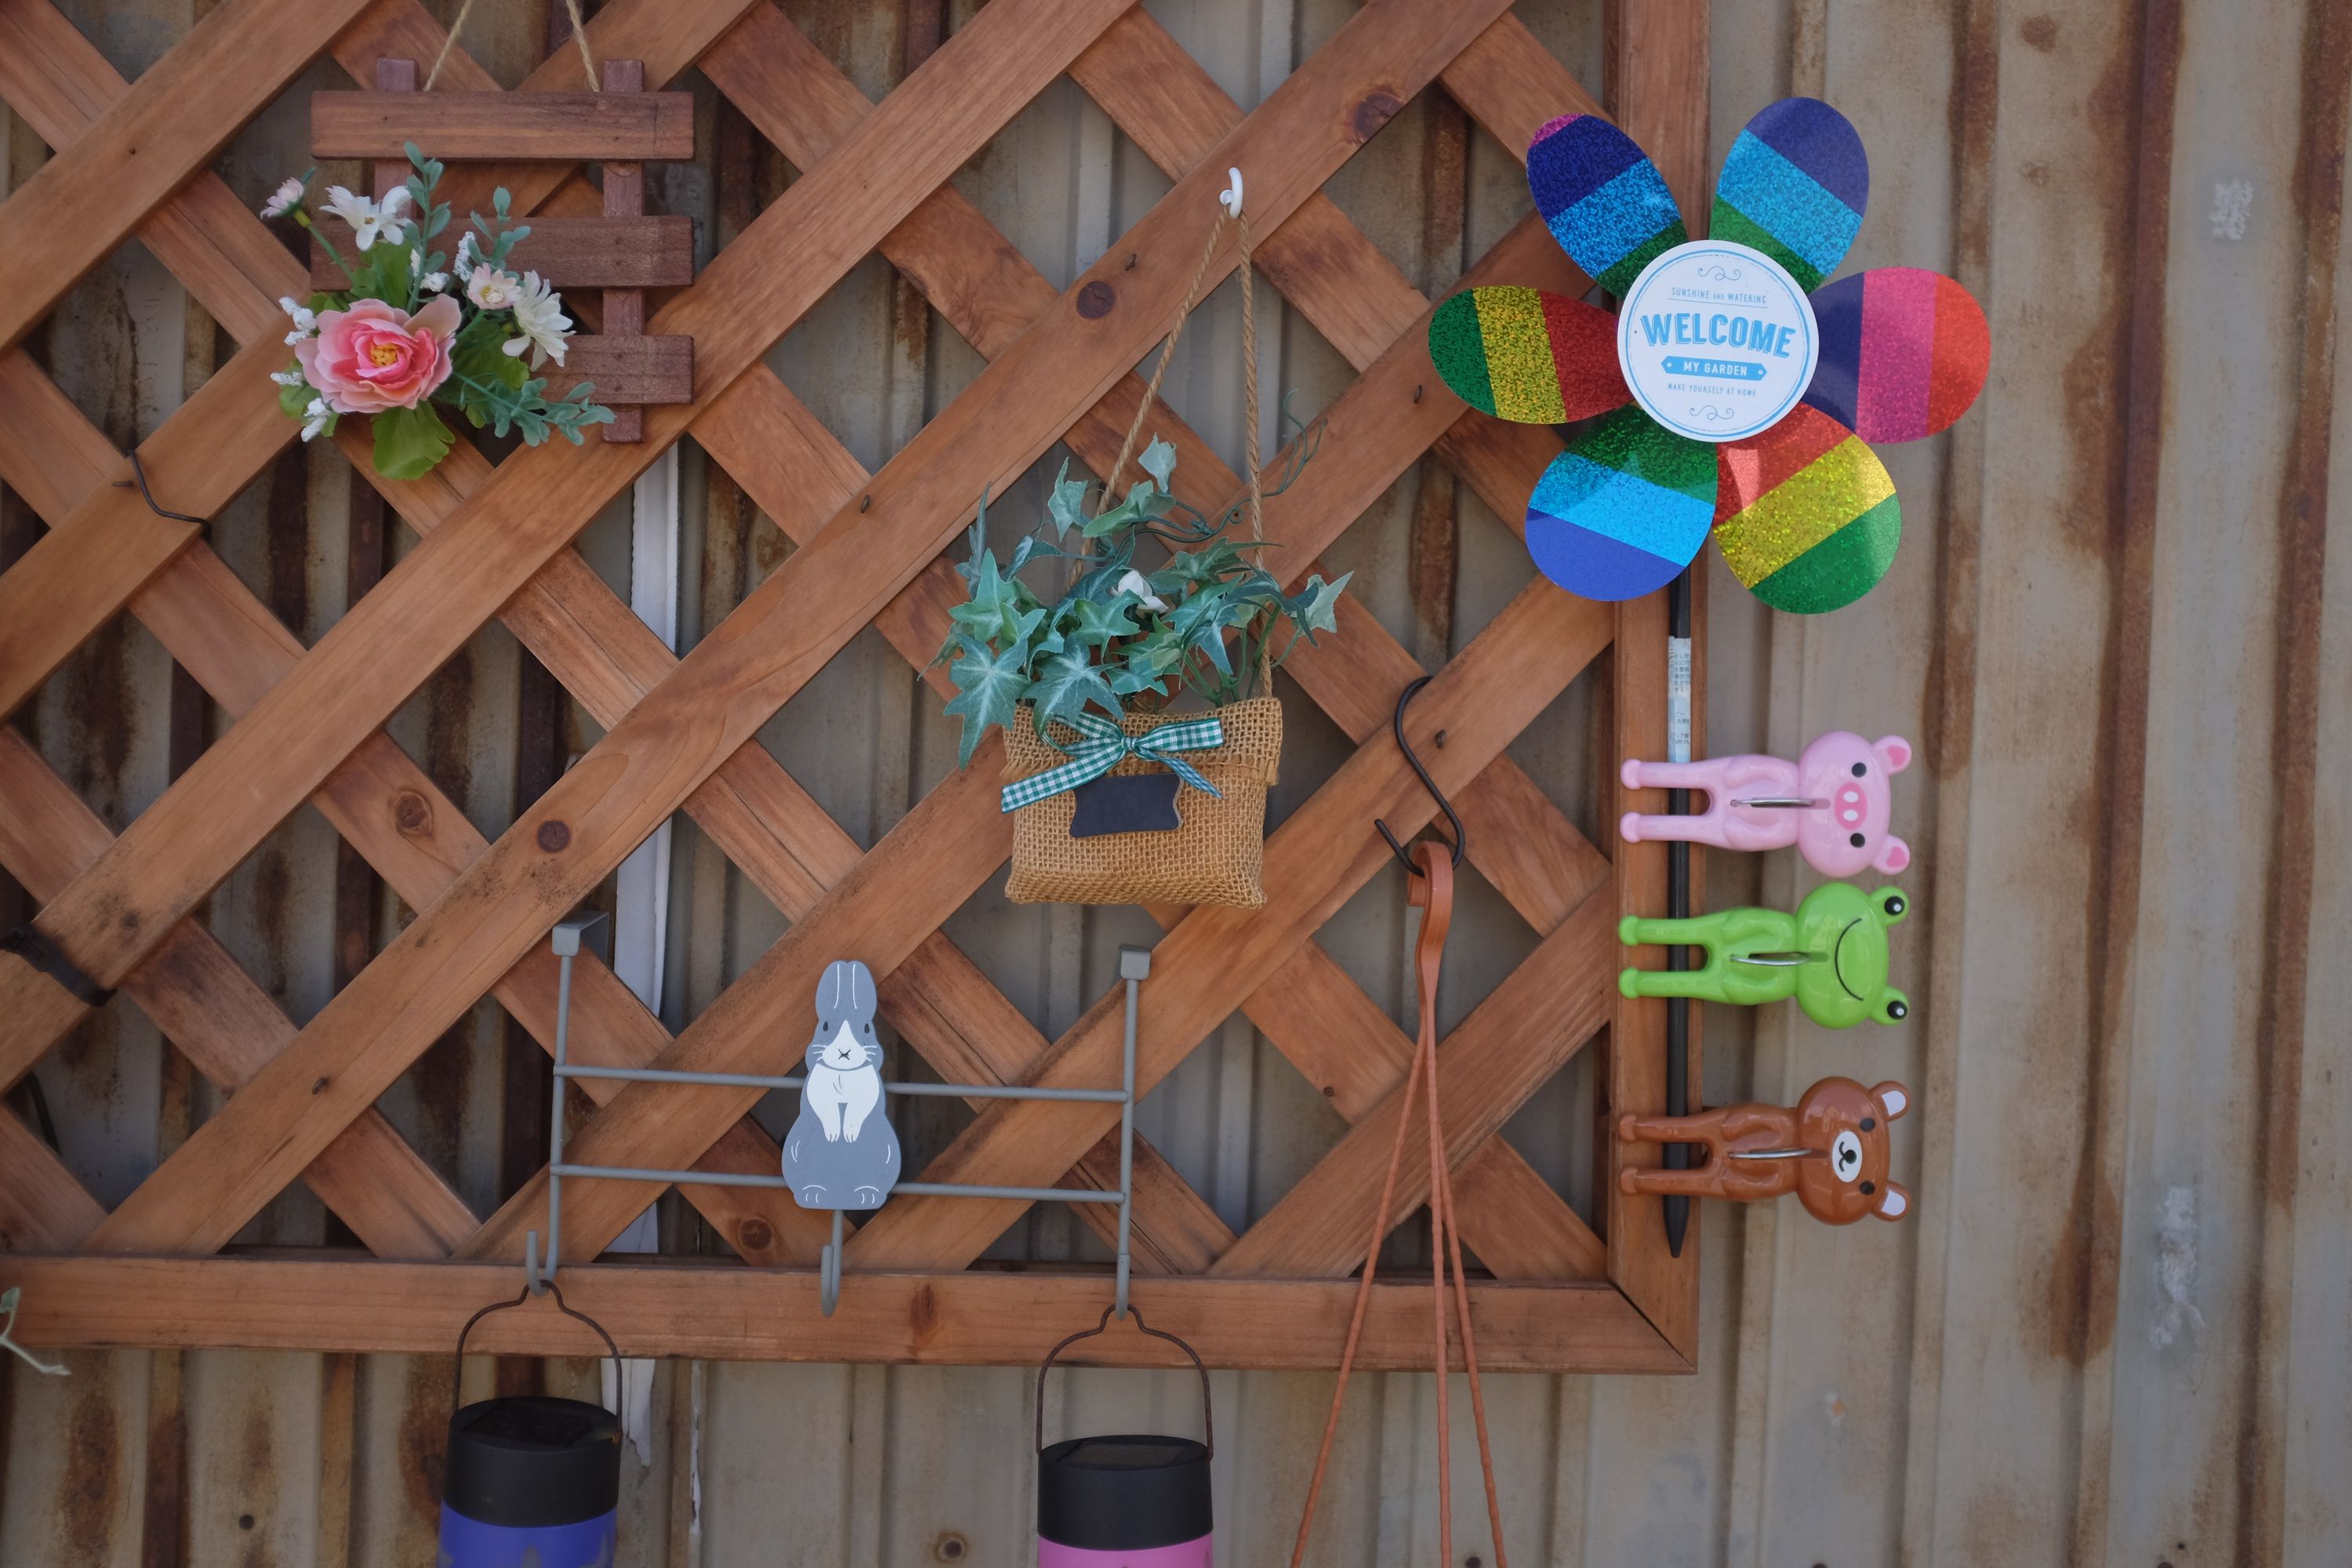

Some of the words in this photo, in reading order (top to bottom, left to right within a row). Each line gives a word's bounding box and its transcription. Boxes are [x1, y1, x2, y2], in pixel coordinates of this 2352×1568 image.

[1671, 287, 1710, 299] SUNSHINE
[1727, 292, 1766, 304] WATERING
[1640, 314, 1796, 358] WELCOME
[1683, 361, 1700, 372] MY
[1704, 363, 1747, 376] GARDEN
[1668, 383, 1686, 392] MAKE
[1689, 384, 1723, 394] YOURSELF
[1726, 387, 1734, 395] AT
[1737, 388, 1756, 397] HOME
